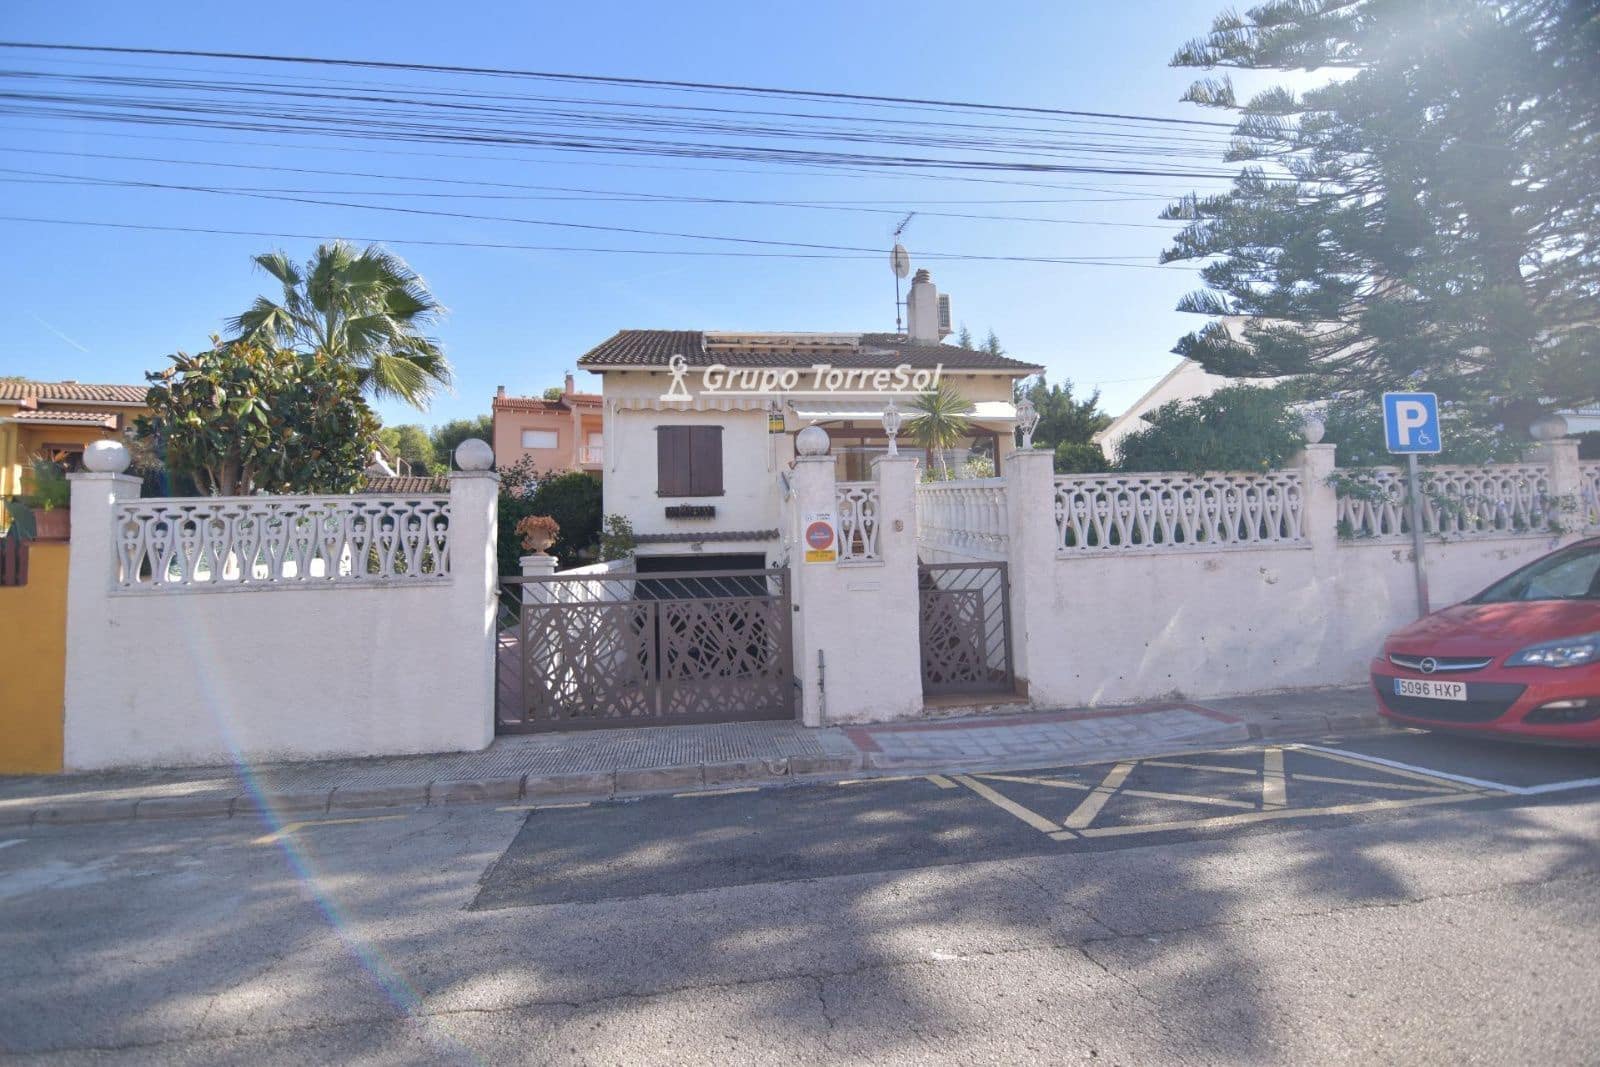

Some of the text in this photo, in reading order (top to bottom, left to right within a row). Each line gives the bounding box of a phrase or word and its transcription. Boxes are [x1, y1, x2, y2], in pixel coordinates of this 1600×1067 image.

[1396, 401, 1428, 445] P
[1401, 681, 1462, 697] 5096 HXP
